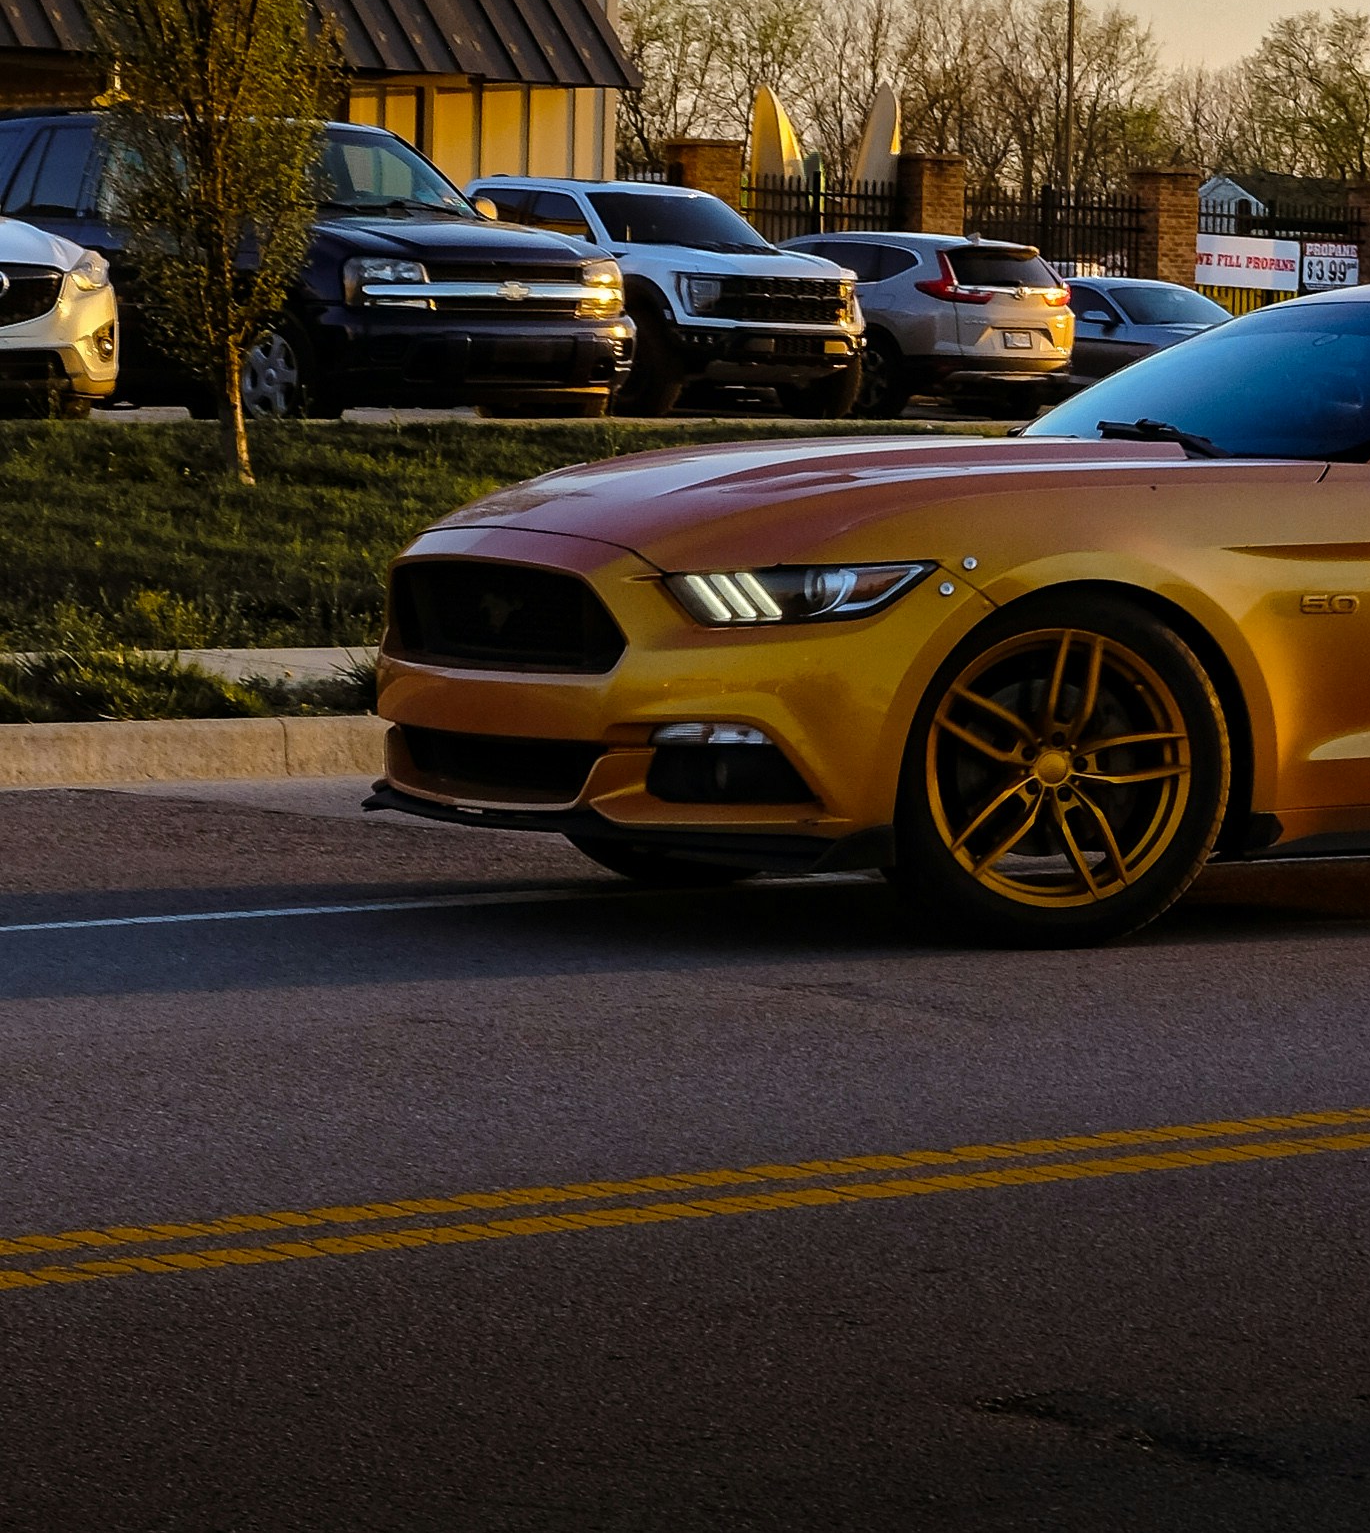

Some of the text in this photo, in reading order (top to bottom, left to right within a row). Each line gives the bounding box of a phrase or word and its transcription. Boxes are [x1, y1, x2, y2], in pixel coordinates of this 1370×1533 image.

[1305, 243, 1358, 257] PROPANE
[1196, 253, 1296, 272] WE FILL PROPANE
